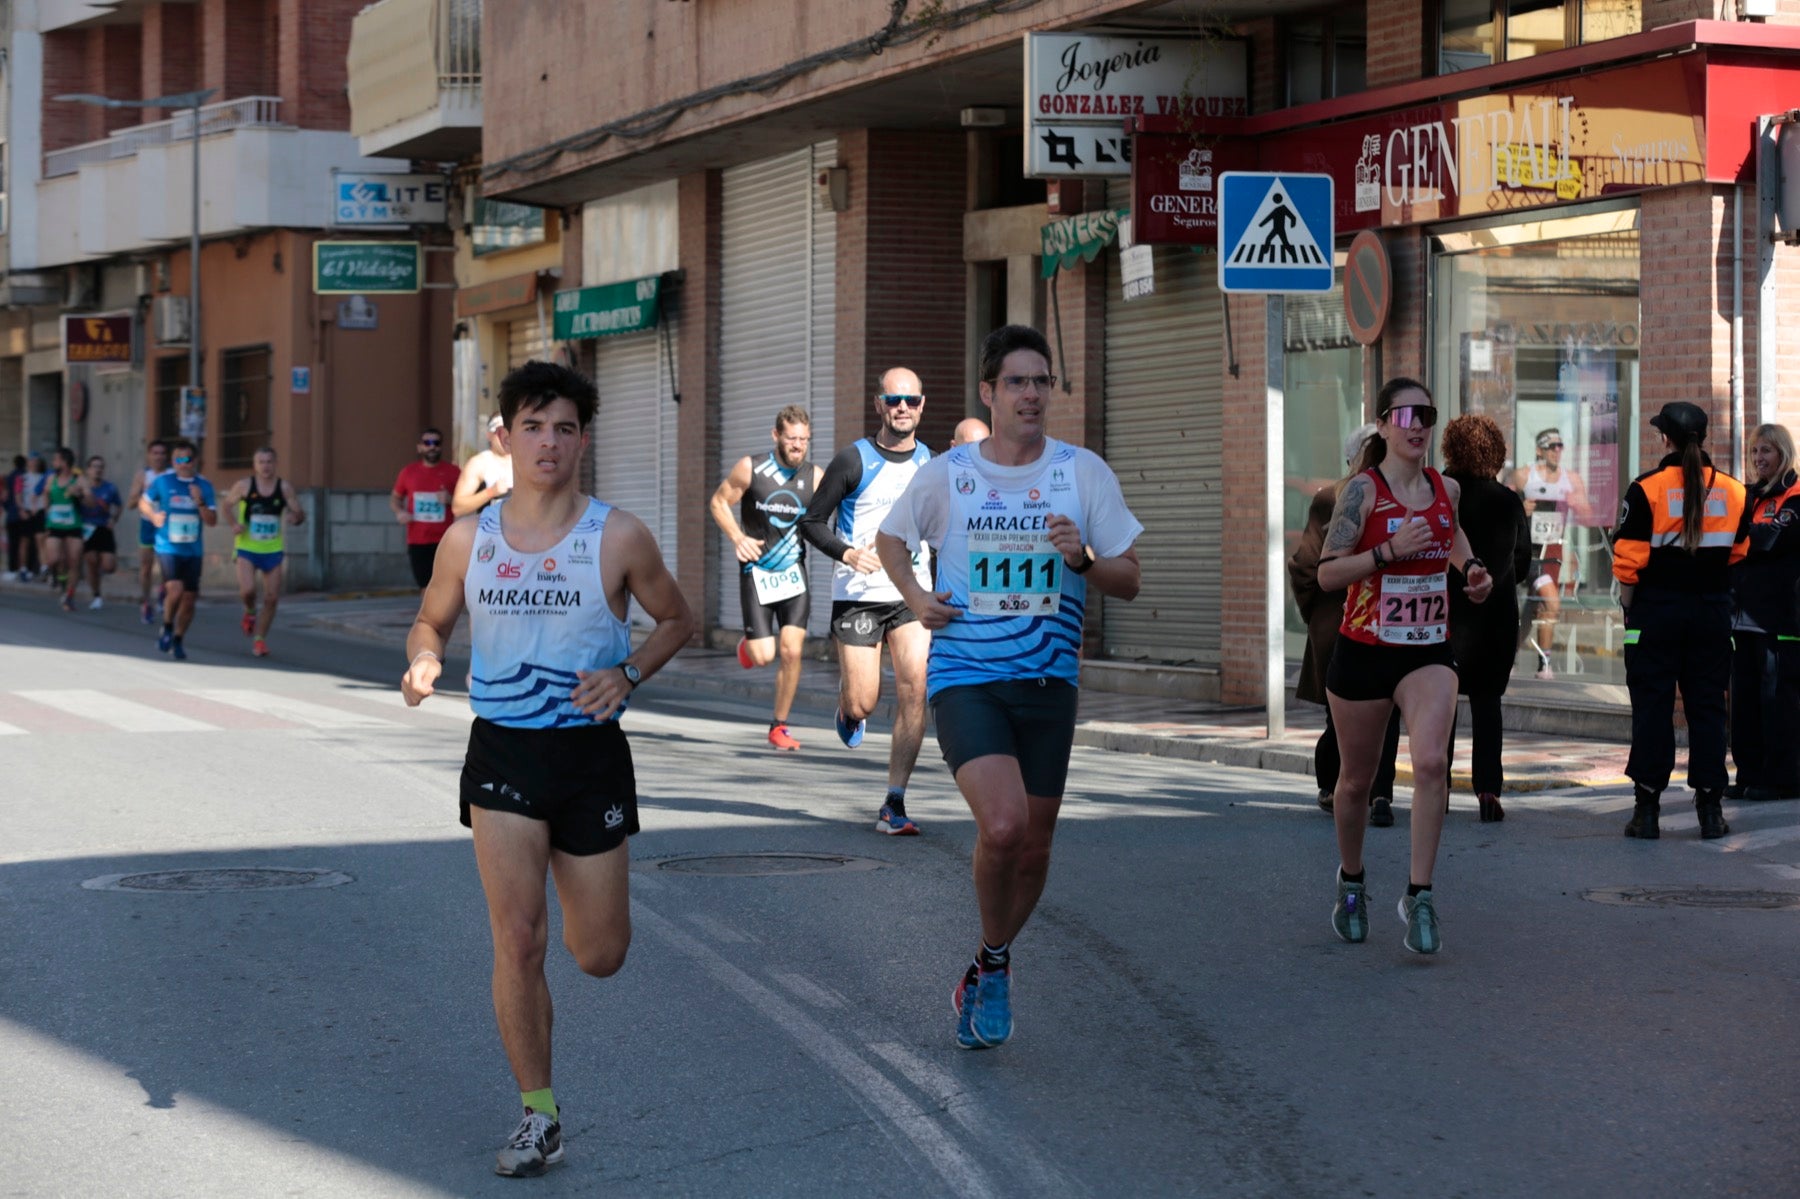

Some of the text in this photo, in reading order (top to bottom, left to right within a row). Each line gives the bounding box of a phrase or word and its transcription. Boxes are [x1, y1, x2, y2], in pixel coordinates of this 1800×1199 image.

[1039, 94, 1246, 117] GONZALEZ VAZQUEZ
[1384, 95, 1575, 208] GENERALI
[1611, 131, 1690, 180] Seguros
[340, 206, 388, 218] GYM
[1150, 194, 1218, 215] GENER
[1173, 214, 1217, 229] Seguros
[347, 260, 414, 281] Hidalgo
[967, 515, 1048, 531] MARACE
[975, 557, 1055, 588] 1111
[478, 588, 581, 607] MARACENA
[523, 609, 568, 617] ATLETISMO
[1386, 595, 1445, 623] 2172
